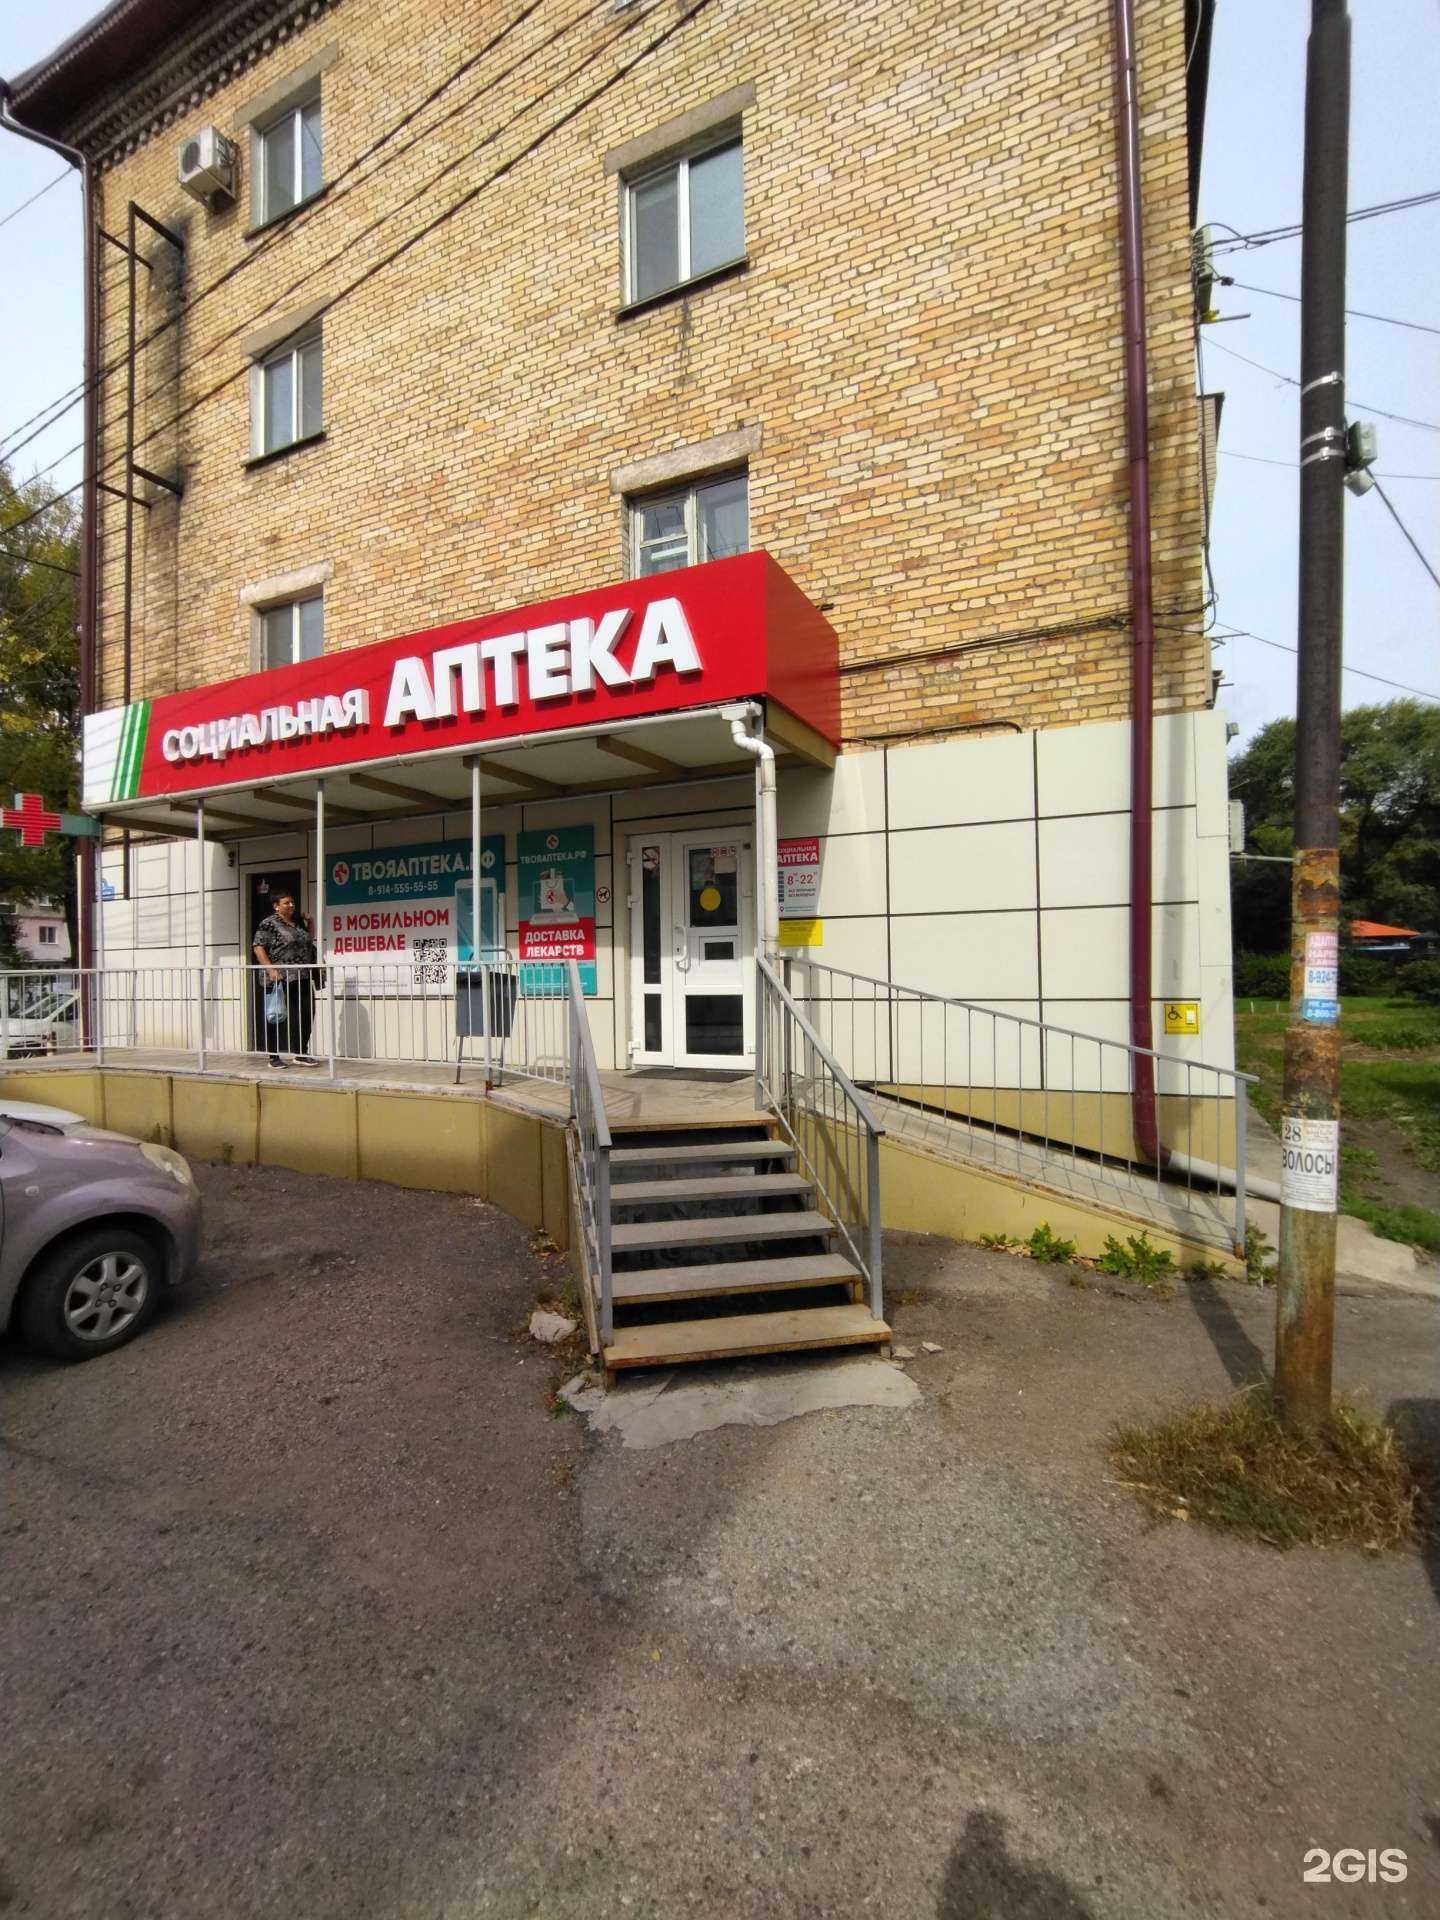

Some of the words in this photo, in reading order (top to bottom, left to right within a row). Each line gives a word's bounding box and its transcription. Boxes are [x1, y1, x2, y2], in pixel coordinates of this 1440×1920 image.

[162, 688, 369, 762] СОЦИАЛЬНАЯ
[383, 597, 703, 727] АПТЕКА
[333, 916, 342, 931] В
[347, 909, 449, 931] МОБИЛЬНОМ
[333, 934, 406, 955] ДЕШЕВЛЕ
[525, 929, 585, 944] ДОСТАВКА
[526, 944, 585, 957] ЛЕКАРСТВ
